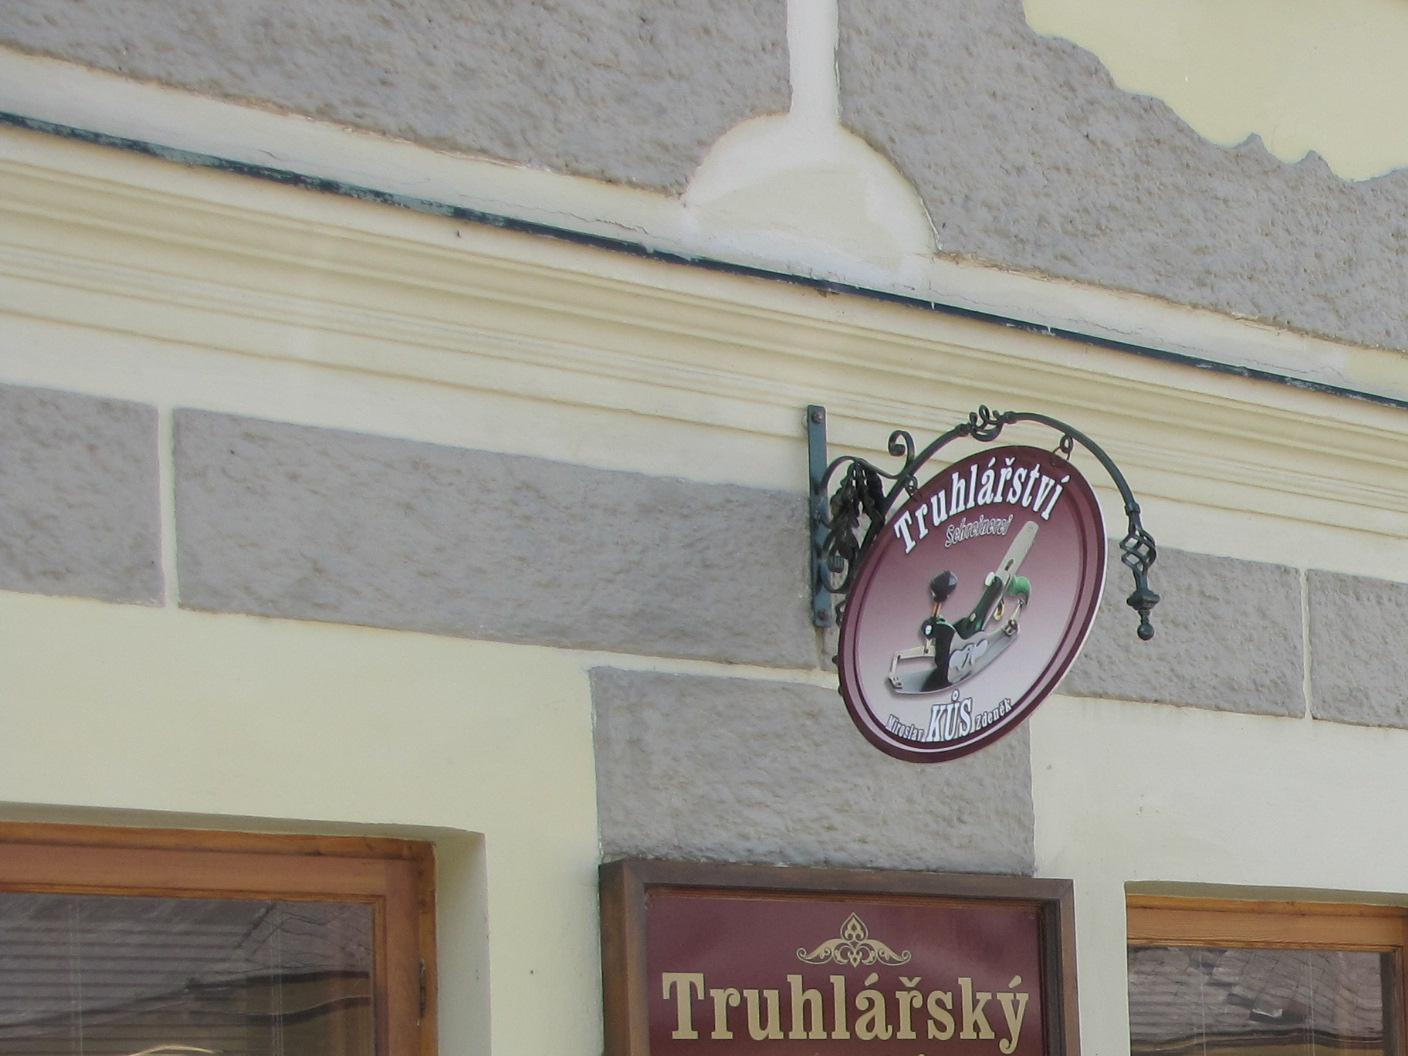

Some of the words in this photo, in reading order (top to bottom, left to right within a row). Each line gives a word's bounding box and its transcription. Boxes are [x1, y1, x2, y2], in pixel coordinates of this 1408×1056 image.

[893, 456, 1071, 555] Truhlářství
[926, 688, 974, 743] KŮS
[975, 698, 1012, 730] Zdeněk
[662, 971, 1030, 1055] Truhlářský
